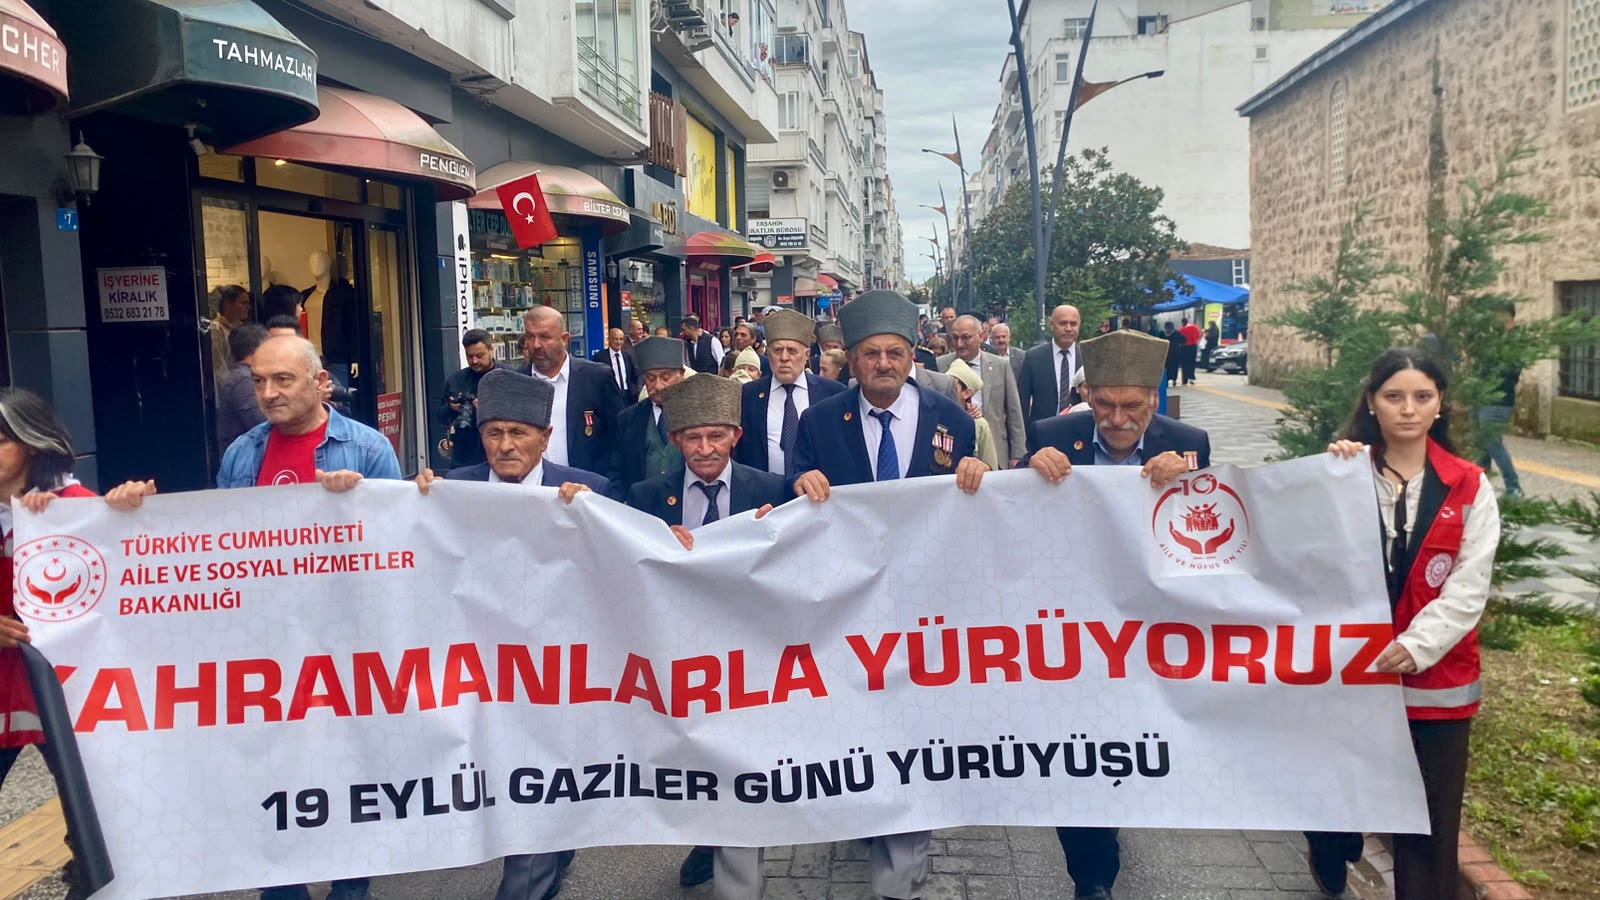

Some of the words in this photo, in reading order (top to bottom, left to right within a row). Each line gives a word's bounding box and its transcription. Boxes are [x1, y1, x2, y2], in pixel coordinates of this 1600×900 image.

[212, 38, 313, 84] TAHMAZLAR
[420, 153, 470, 180] PENGUEN
[583, 200, 611, 215] BİLTER
[103, 272, 160, 290] İŞYERİNE
[587, 250, 599, 309] SAMSUNG
[109, 289, 158, 304] KİRALIK
[104, 308, 124, 320] 0532
[126, 307, 141, 319] 683
[143, 307, 153, 318] 21
[155, 306, 166, 318] 78
[120, 532, 212, 557] TÜRKİYE
[217, 520, 363, 551] CUMHURİYETİ
[119, 563, 169, 586] AİLE
[173, 563, 201, 583] VE
[206, 558, 288, 581] SOSYAL
[293, 551, 415, 576] HİZMETLER
[1159, 543, 1174, 558] AİLE
[1175, 557, 1186, 566] VE
[1223, 554, 1237, 565] ON
[119, 587, 241, 616] BAKANLIĞI
[54, 643, 828, 732] AHRAMANLARLA
[845, 608, 1400, 691] YÜRÜYORUZ
[260, 788, 329, 831] 19
[349, 762, 496, 824] EYLÜL
[508, 753, 719, 805] GAZİLER
[733, 747, 875, 804] GÜNÜ
[886, 732, 1170, 788] YÜRÜYÜŞÜ
